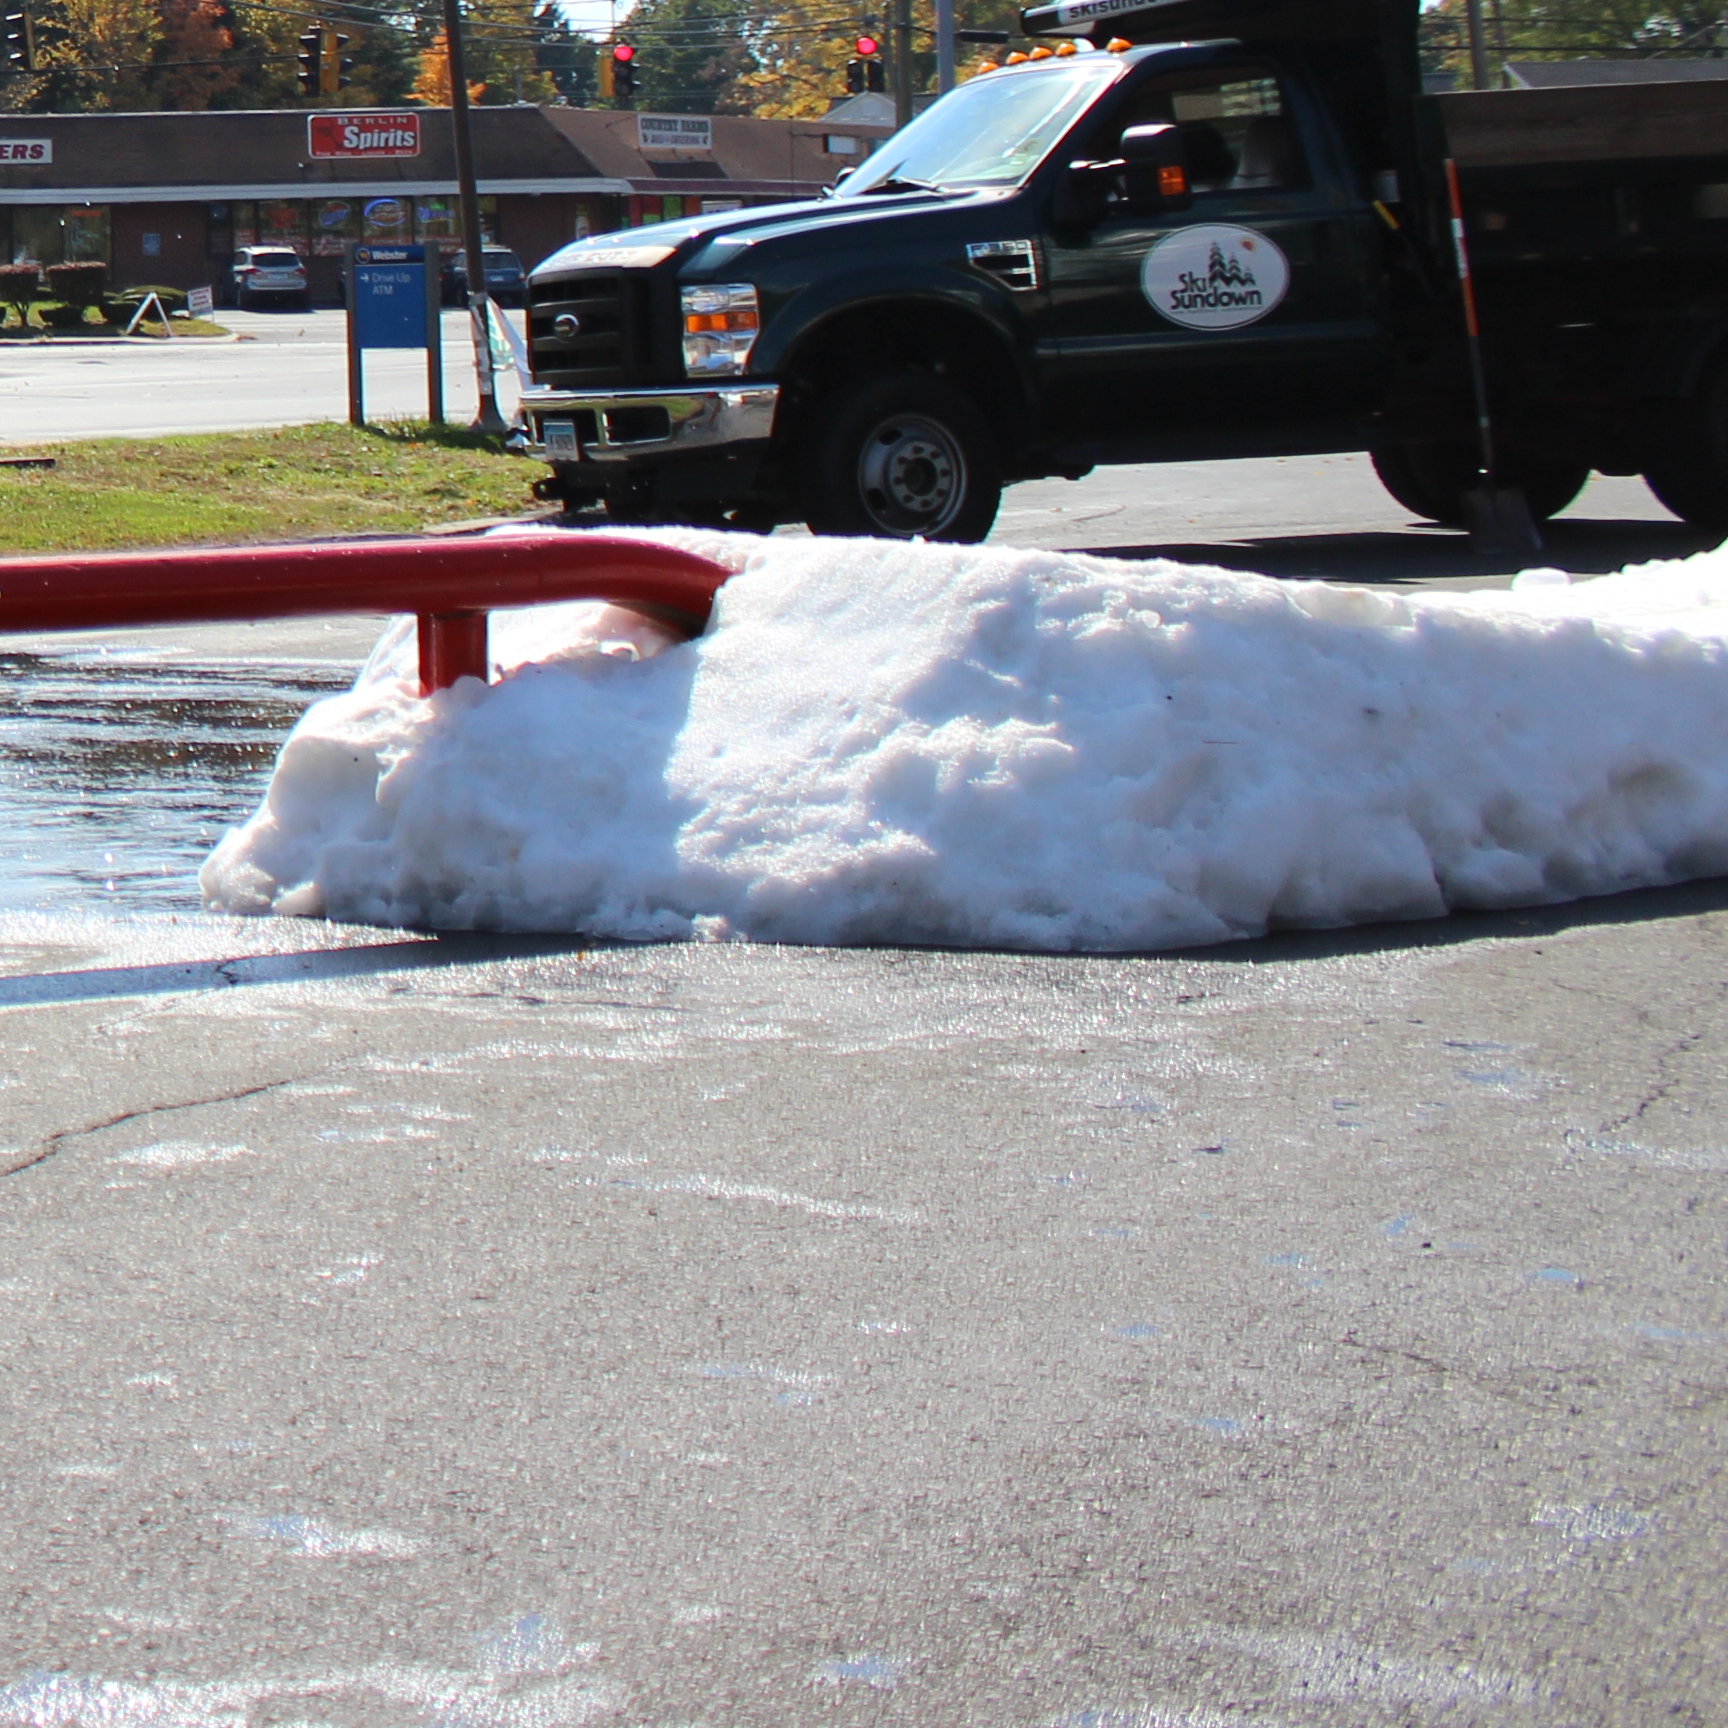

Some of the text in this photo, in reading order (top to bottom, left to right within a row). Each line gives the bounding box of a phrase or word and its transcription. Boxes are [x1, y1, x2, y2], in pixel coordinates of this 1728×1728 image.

[337, 116, 408, 126] BERLIN
[343, 125, 416, 150] Spirits
[371, 250, 409, 261] Webster
[372, 272, 411, 284] Drive Up
[1178, 271, 1206, 293] Ski
[372, 284, 393, 294] ATM
[1169, 286, 1263, 310] Sundown
